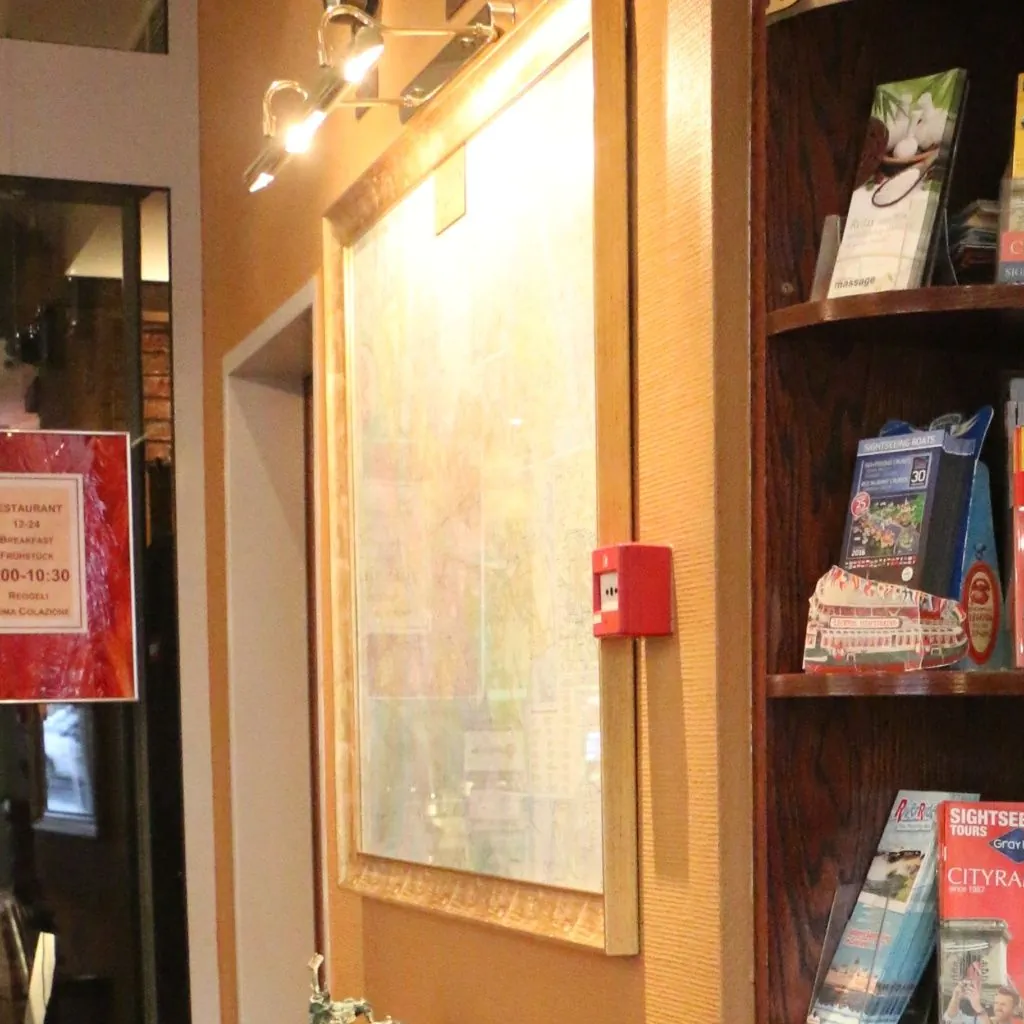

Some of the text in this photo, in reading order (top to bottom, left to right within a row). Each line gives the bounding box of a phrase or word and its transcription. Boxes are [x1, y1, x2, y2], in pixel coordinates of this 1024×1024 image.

[834, 276, 876, 288] massage
[912, 436, 936, 446] BOATS
[911, 470, 926, 482] 30
[14, 520, 40, 528] 12-24
[950, 824, 988, 836] TOURS
[994, 839, 1020, 850] Gray
